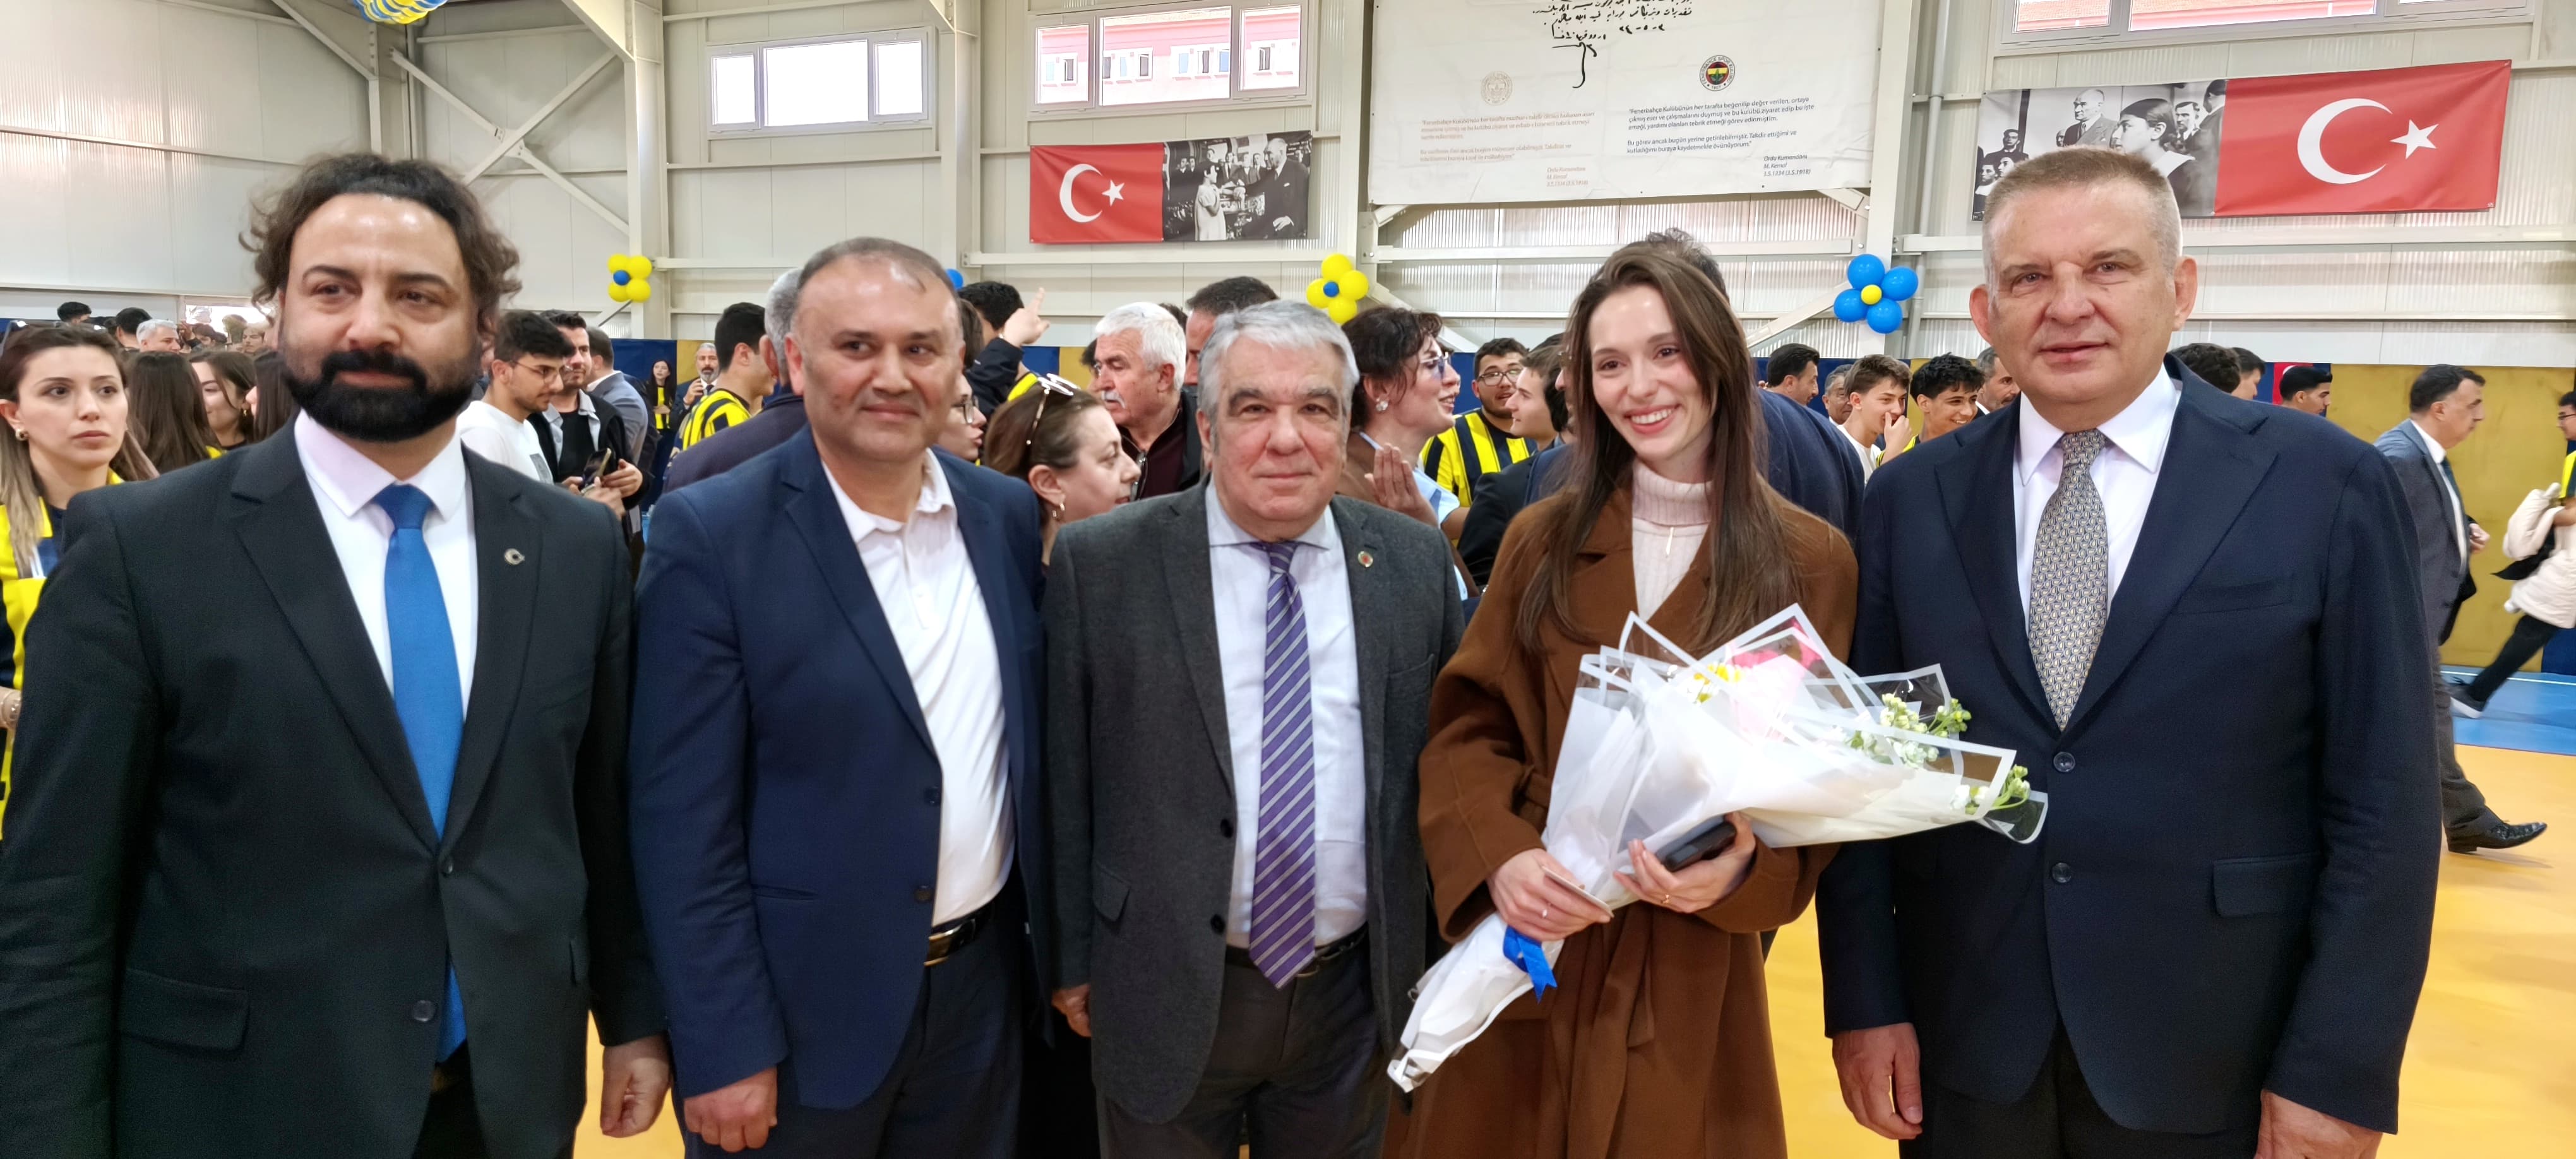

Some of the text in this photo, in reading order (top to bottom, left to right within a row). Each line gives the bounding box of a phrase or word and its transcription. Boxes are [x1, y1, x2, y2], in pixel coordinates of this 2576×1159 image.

[1666, 112, 1700, 120] çalışmalarını
[1761, 106, 1780, 114] ziyaret
[1767, 130, 1789, 138] ettiğimi
[1627, 146, 1657, 154] kutladığımı
[1677, 143, 1712, 152] kaydetmekle
